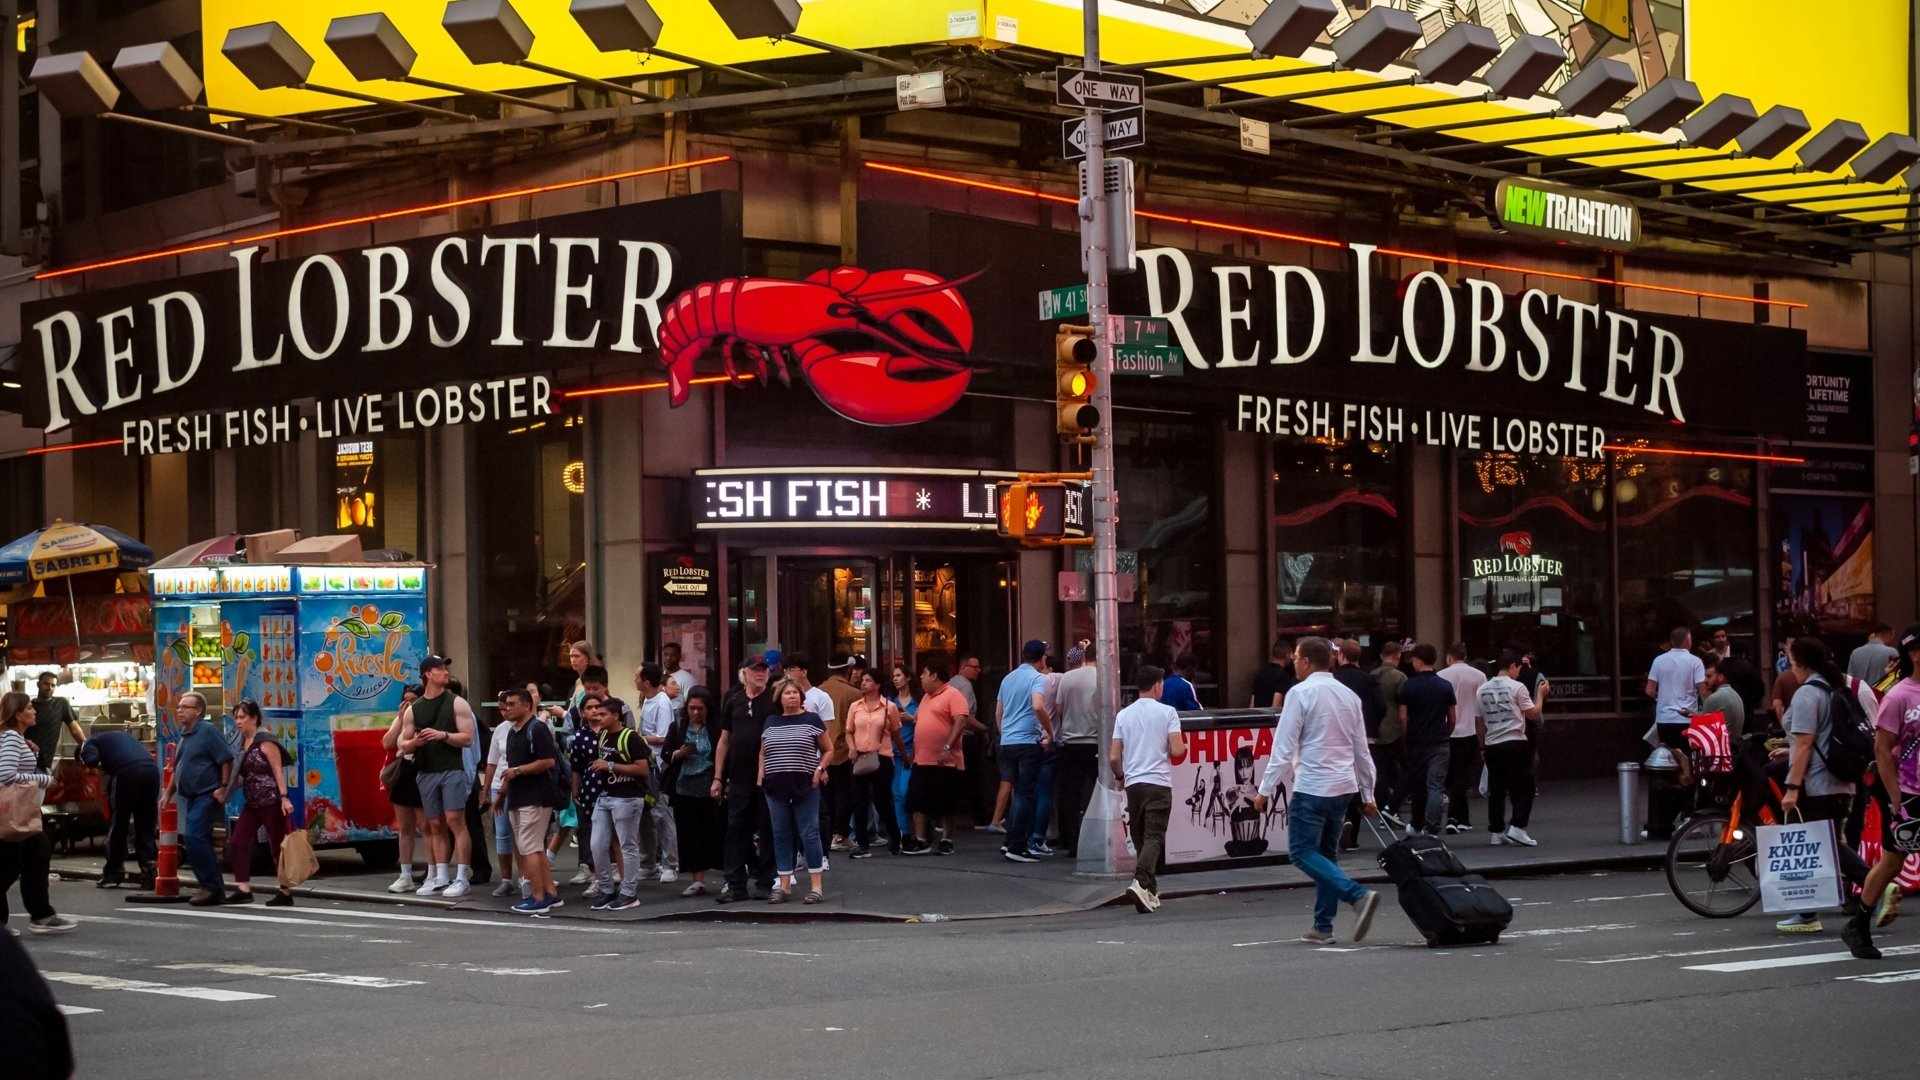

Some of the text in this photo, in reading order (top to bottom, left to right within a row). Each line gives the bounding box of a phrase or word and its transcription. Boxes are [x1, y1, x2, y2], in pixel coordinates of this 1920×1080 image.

[1074, 81, 1134, 101] ONE WAY
[1108, 120, 1133, 138] WAY
[1052, 293, 1061, 314] W
[1065, 291, 1076, 313] 41
[34, 233, 674, 433] RED LOBSTER
[1134, 320, 1142, 341] 7
[1146, 325, 1156, 334] Av
[1136, 243, 1686, 422] RED LOBSTER
[1116, 349, 1178, 371] Fashion Av
[1806, 374, 1850, 388] ORTUNITY
[1809, 389, 1849, 402] LIFETIME
[124, 375, 552, 456] FRESH FISH LIVE LOBSTER
[1238, 394, 1606, 460] FRESH FISH LIVE LOBSTER
[787, 480, 887, 517] FISH
[962, 482, 997, 518] LI
[35, 551, 113, 575] SABRETT
[663, 566, 710, 578] RED LOBSTER
[1472, 554, 1563, 577] RED LOBSTER
[1169, 727, 1274, 766] CHICA
[1780, 830, 1807, 844] WE
[1768, 842, 1821, 858] KNOW
[1770, 857, 1822, 872] GAME.
